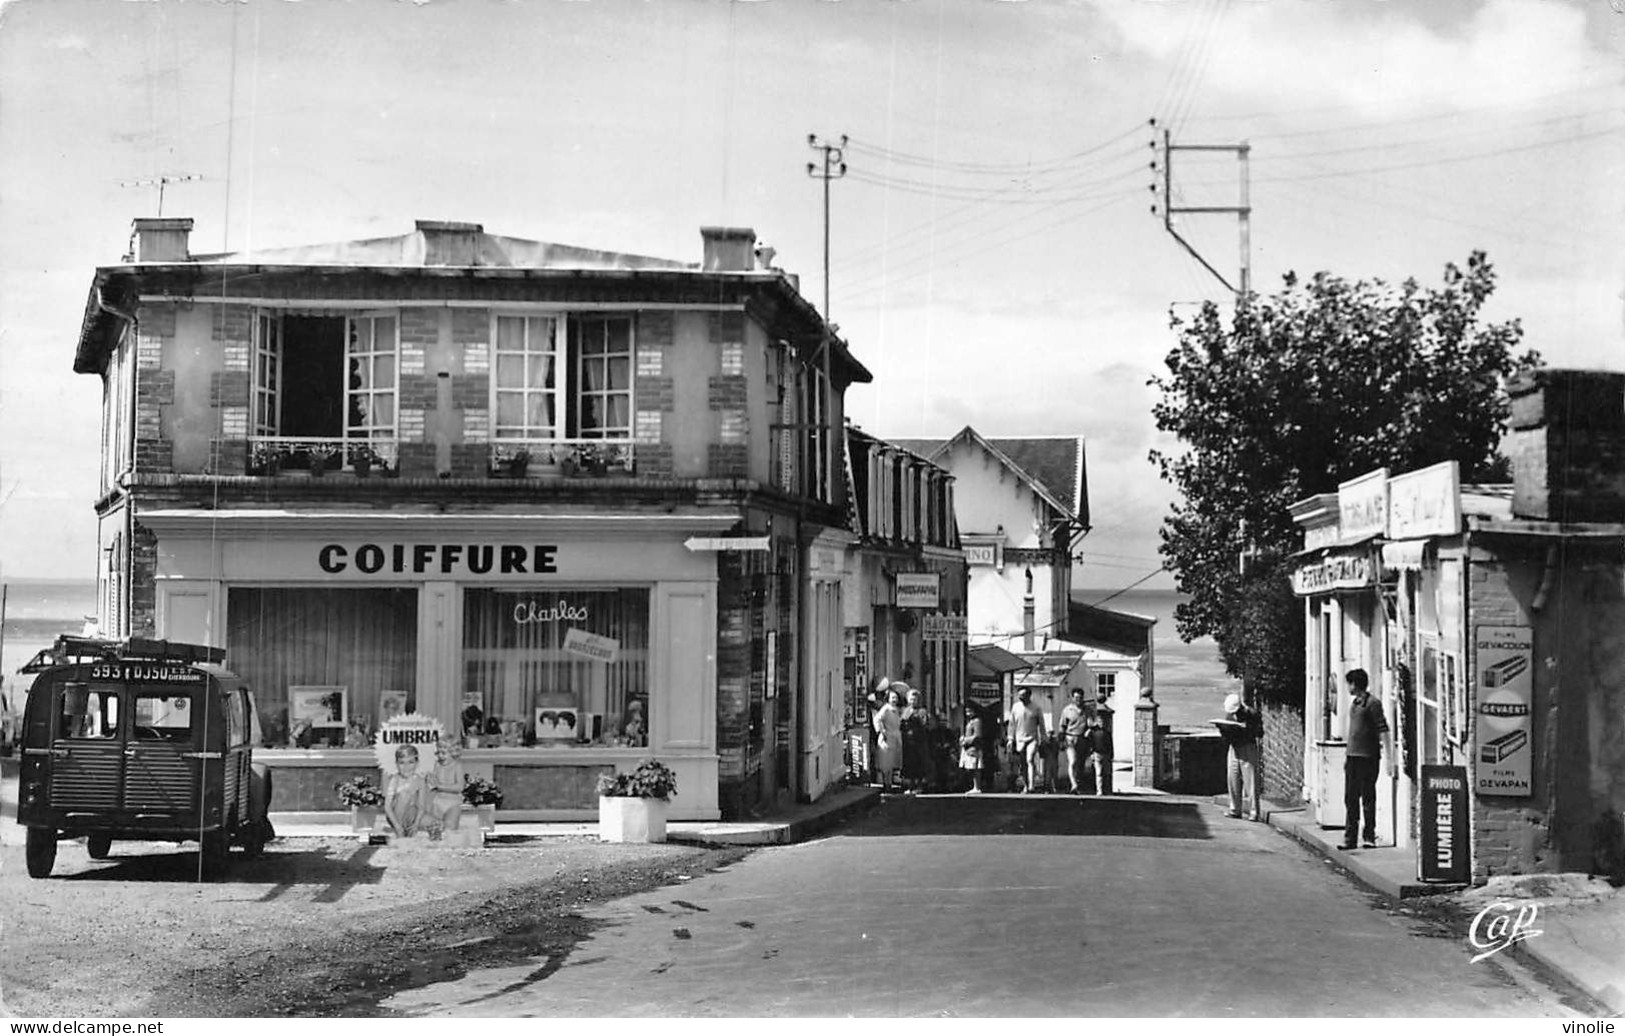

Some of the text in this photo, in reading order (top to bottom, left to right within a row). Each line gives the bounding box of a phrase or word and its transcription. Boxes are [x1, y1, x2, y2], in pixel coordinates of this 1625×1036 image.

[318, 544, 558, 574] COIFFURE
[513, 600, 588, 624] Charles
[92, 664, 121, 679] 393
[1481, 704, 1527, 715] GEVAERT
[383, 730, 439, 744] UMBRIA
[1429, 778, 1461, 790] PHOTO
[1479, 779, 1529, 789] GEVAPAN
